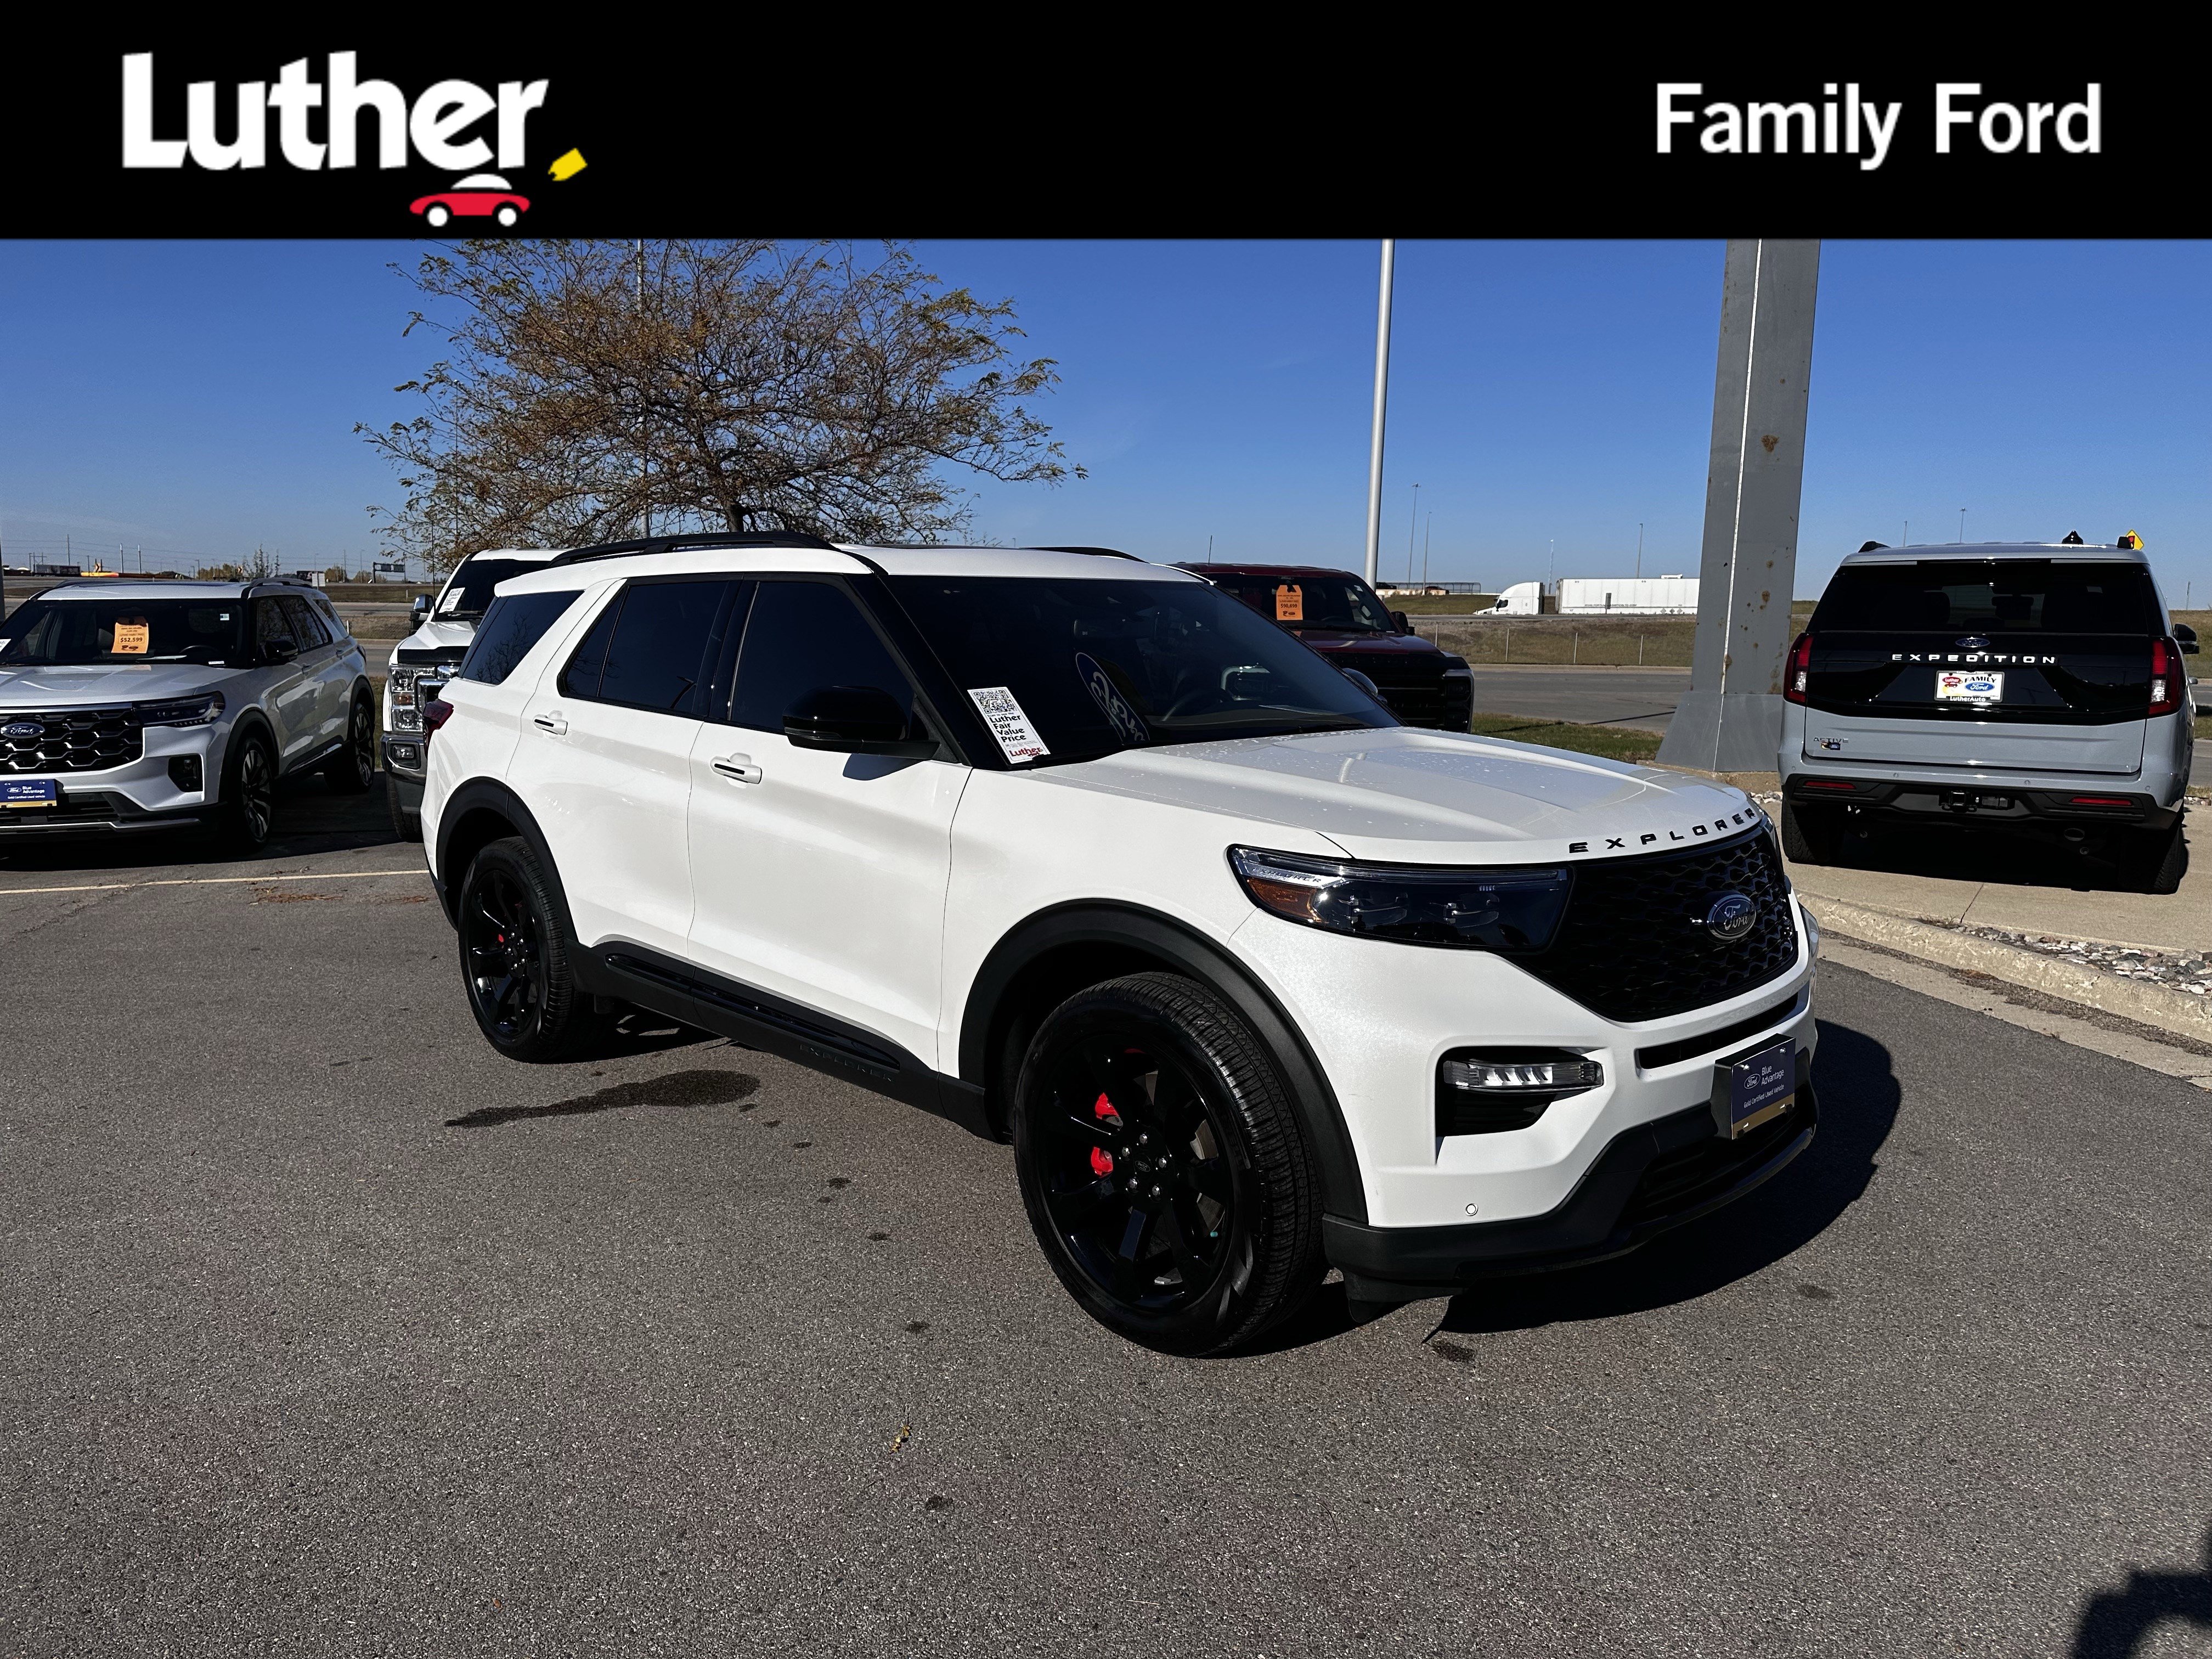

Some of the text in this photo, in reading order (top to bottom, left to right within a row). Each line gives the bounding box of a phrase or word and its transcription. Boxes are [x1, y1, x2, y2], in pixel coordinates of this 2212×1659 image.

[1892, 654, 2055, 664] EXPEDITION
[989, 715, 1021, 723] Luther
[1001, 735, 1027, 743] Price
[1009, 747, 1041, 757] Luther
[1568, 808, 1756, 854] EXPLORER
[1723, 904, 1749, 931] Ford
[1762, 1065, 1772, 1076] Blue
[1747, 1075, 1758, 1088] Ford
[1760, 1069, 1784, 1087] Advantage
[1751, 1092, 1765, 1104] Certified
[1765, 1088, 1774, 1098] Used
[1773, 1084, 1785, 1093] Vehicle
